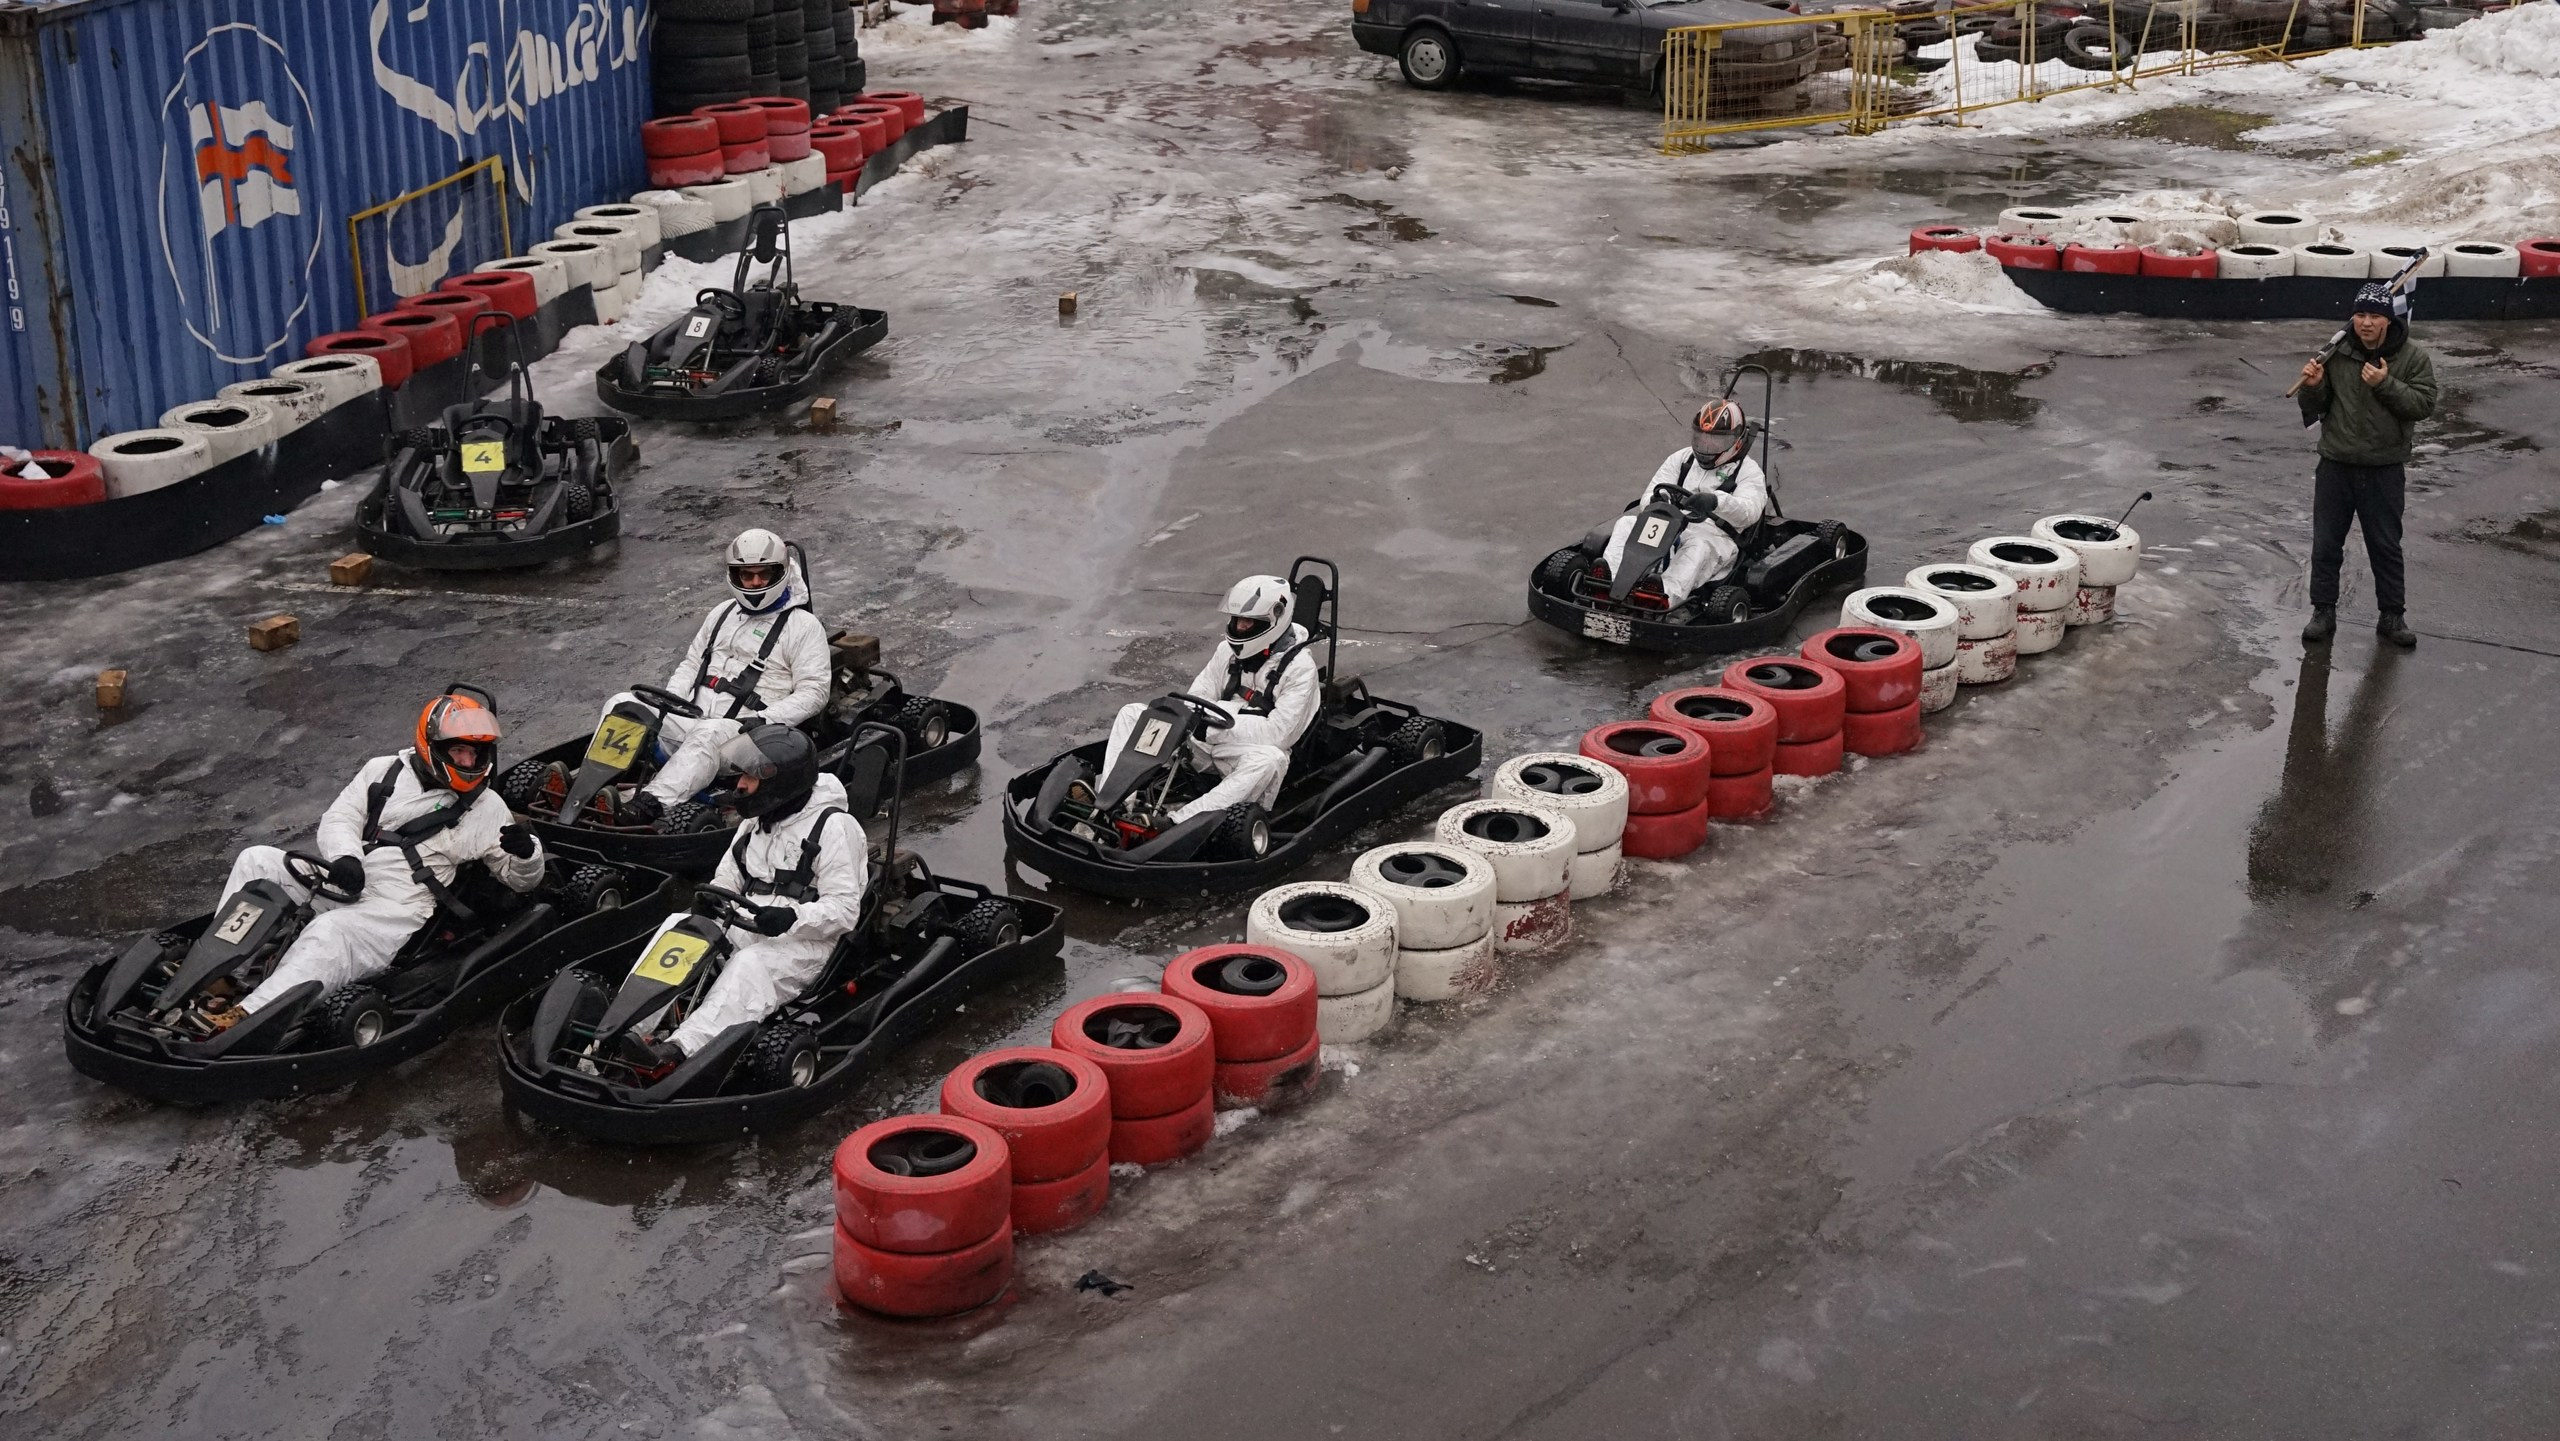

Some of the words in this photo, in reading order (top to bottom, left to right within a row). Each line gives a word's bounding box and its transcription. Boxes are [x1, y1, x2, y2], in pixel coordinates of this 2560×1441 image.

[370, 0, 657, 297] Safmari
[4, 236, 20, 300] 119
[11, 308, 24, 330] 9
[693, 321, 703, 333] 8
[474, 450, 492, 464] 4
[1647, 523, 1659, 540] 3
[601, 727, 632, 756] 14
[1149, 728, 1161, 747] 1
[230, 911, 251, 933] 5
[659, 946, 686, 969] 6
